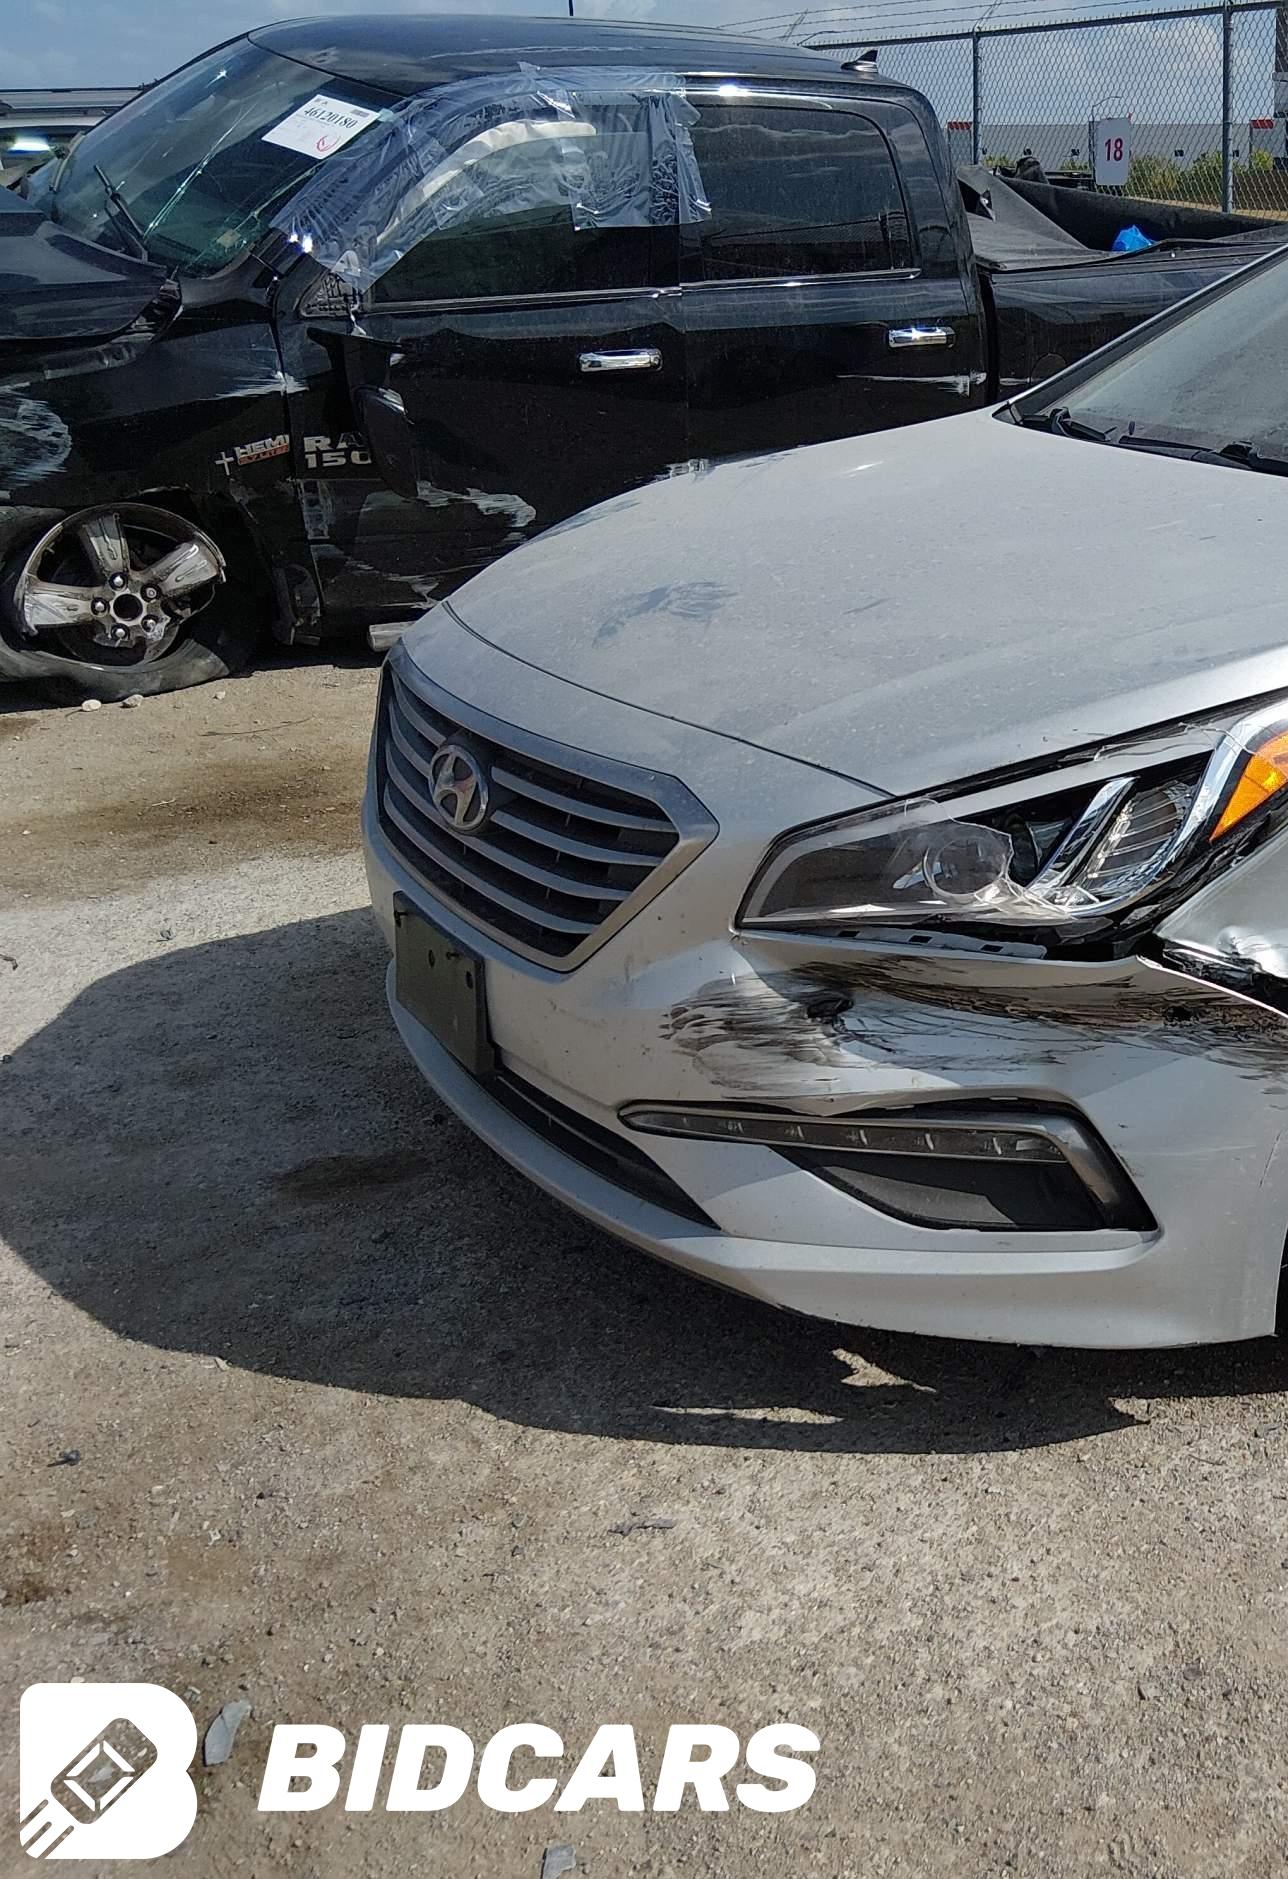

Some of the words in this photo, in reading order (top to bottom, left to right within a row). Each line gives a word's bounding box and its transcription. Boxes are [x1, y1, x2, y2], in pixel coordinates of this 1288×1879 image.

[304, 107, 359, 129] 46120180
[1104, 138, 1124, 162] 18
[234, 434, 290, 457] HEMI
[303, 432, 365, 452] RA
[304, 451, 372, 468] 150
